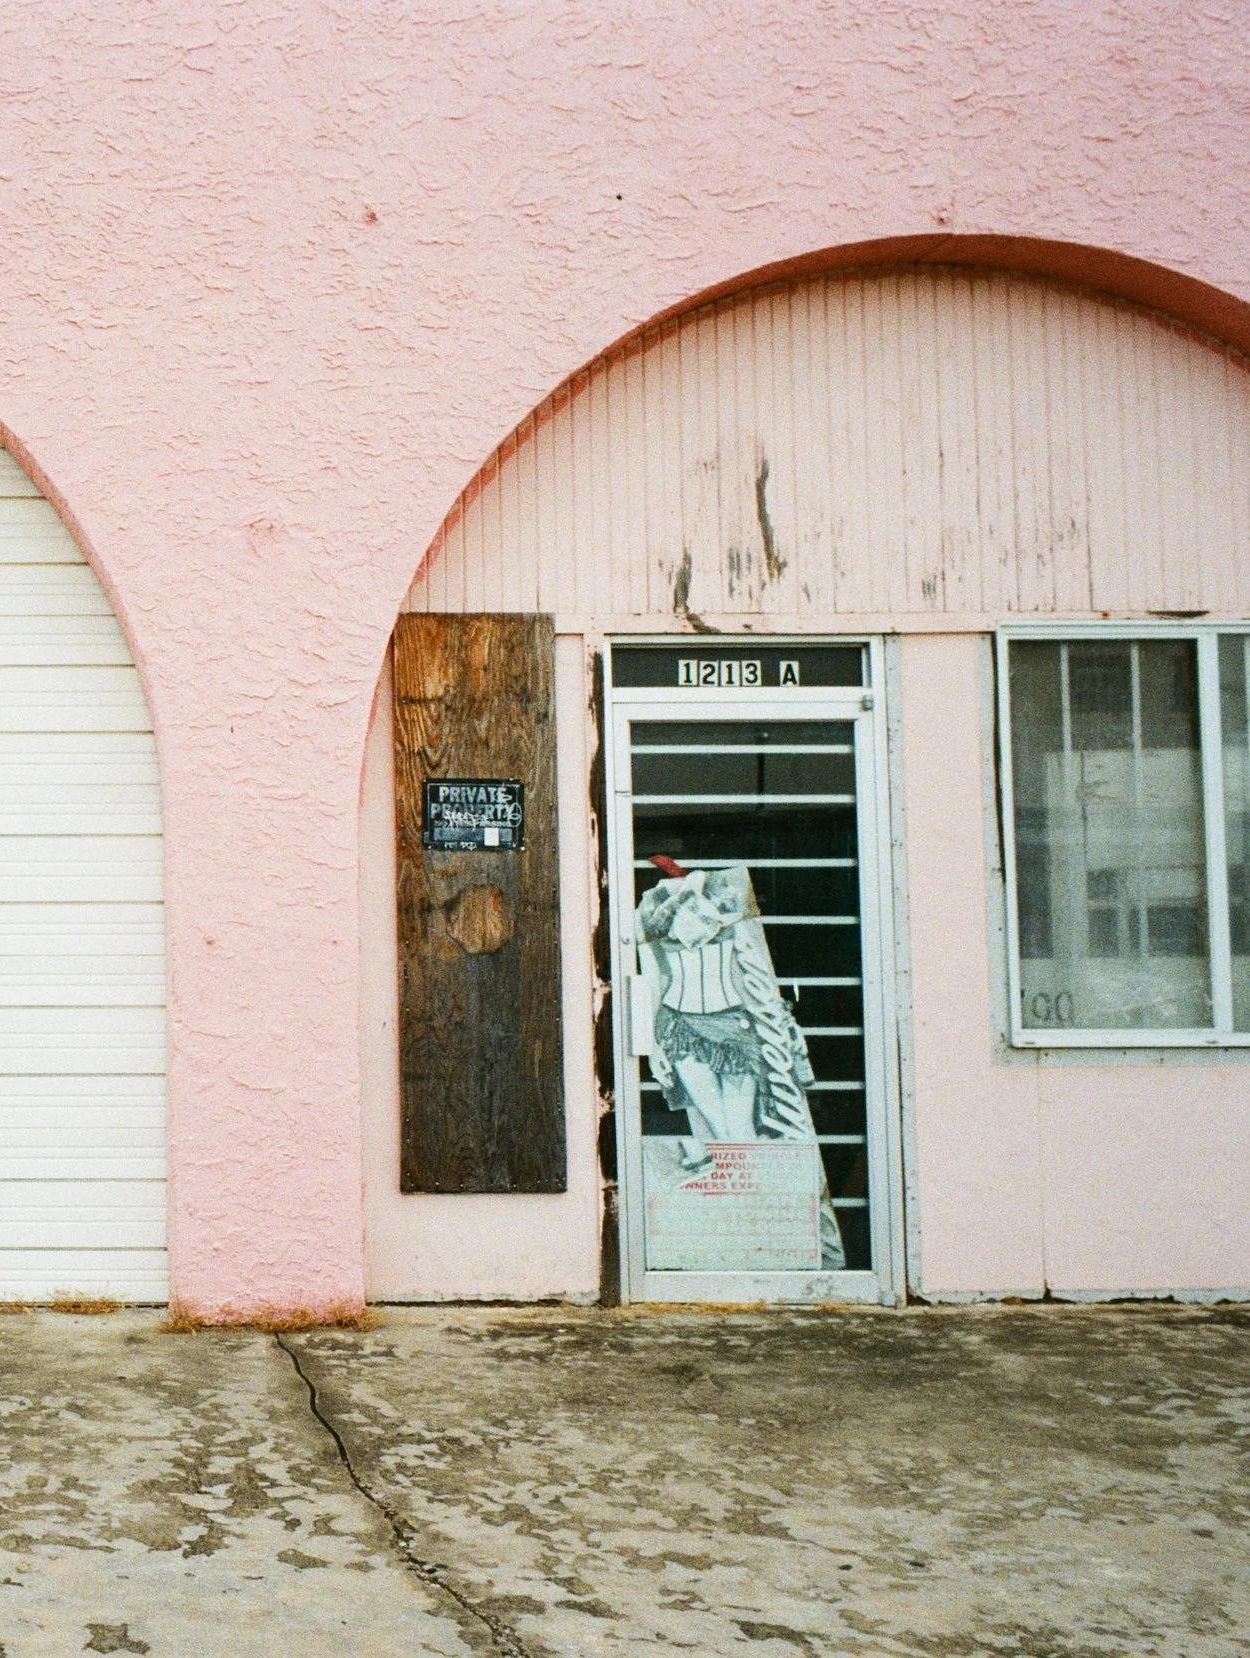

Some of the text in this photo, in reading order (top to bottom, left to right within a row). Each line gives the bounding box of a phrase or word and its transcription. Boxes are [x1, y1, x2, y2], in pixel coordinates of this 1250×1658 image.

[682, 662, 798, 685] 1213 A
[439, 786, 507, 803] PRIVATE
[431, 803, 515, 820] PROPERTY
[710, 1171, 733, 1180] DAY
